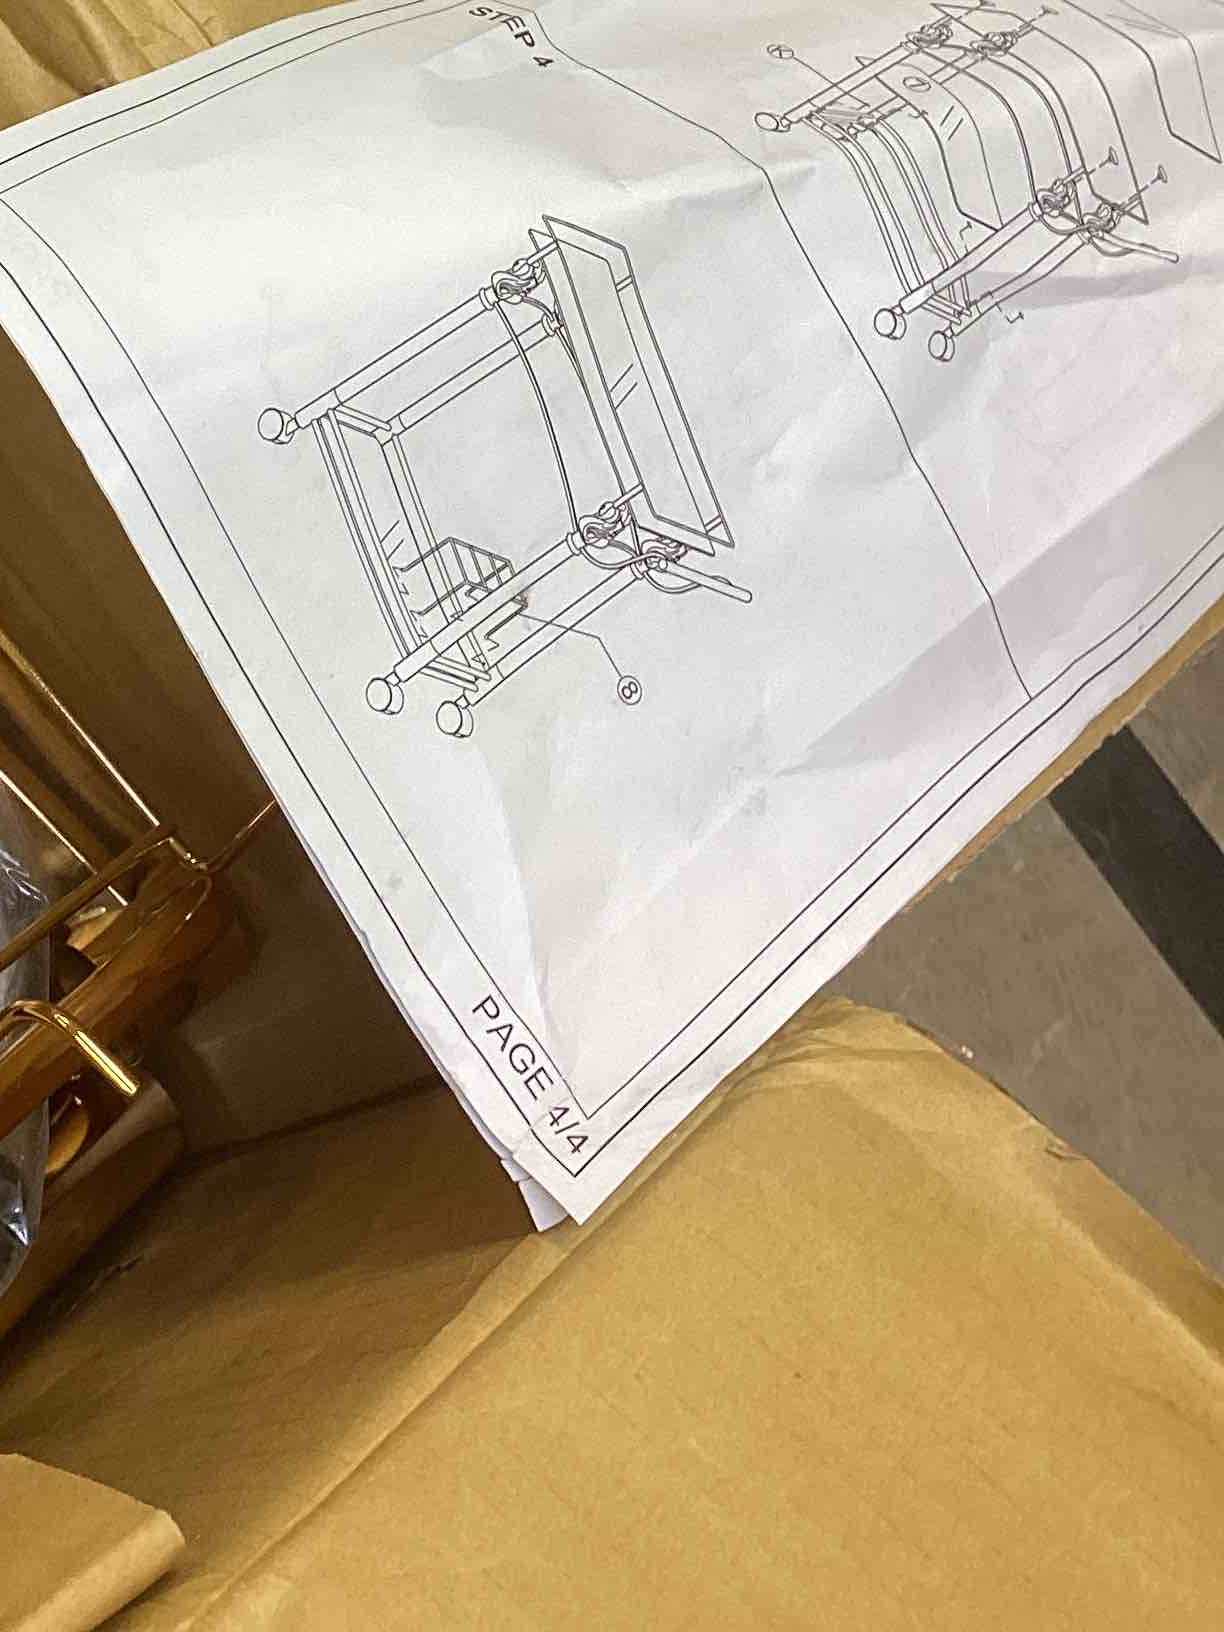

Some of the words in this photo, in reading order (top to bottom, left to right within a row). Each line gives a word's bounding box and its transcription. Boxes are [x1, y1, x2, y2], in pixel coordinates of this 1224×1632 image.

[468, 6, 535, 48] STEP
[532, 56, 554, 67] 4
[472, 995, 554, 1101] PAGE
[549, 1105, 589, 1153] 4/4
